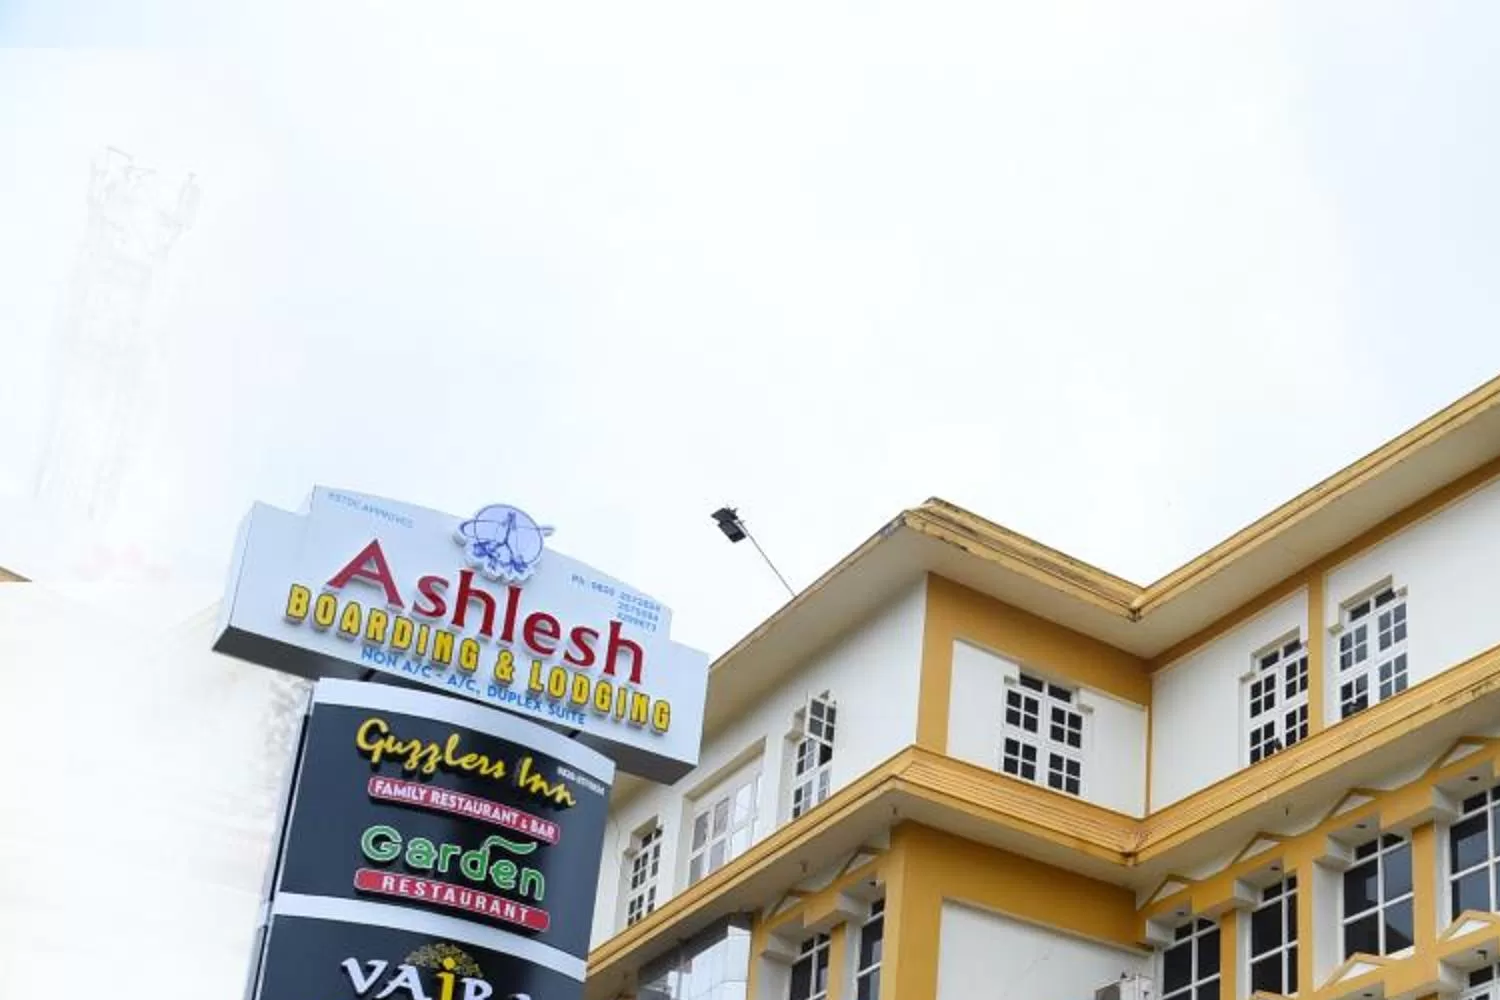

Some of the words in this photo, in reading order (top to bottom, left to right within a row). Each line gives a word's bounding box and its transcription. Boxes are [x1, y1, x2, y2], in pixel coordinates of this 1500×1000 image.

[327, 538, 645, 685] Ashlesh
[285, 583, 480, 673] BOARDING
[494, 649, 515, 683] &
[528, 659, 671, 734] LODGING
[361, 649, 397, 668] NON
[402, 661, 432, 679] A/C
[487, 684, 541, 712] DUPLEX
[548, 702, 588, 725] SUITE
[356, 717, 506, 778] Guzzlers
[519, 757, 577, 808] Inn
[375, 779, 427, 801] FAMILY
[430, 789, 518, 827] RESTAURANT
[531, 820, 556, 840] BAR
[361, 825, 545, 901] Garden
[382, 874, 531, 923] RESTAURANT
